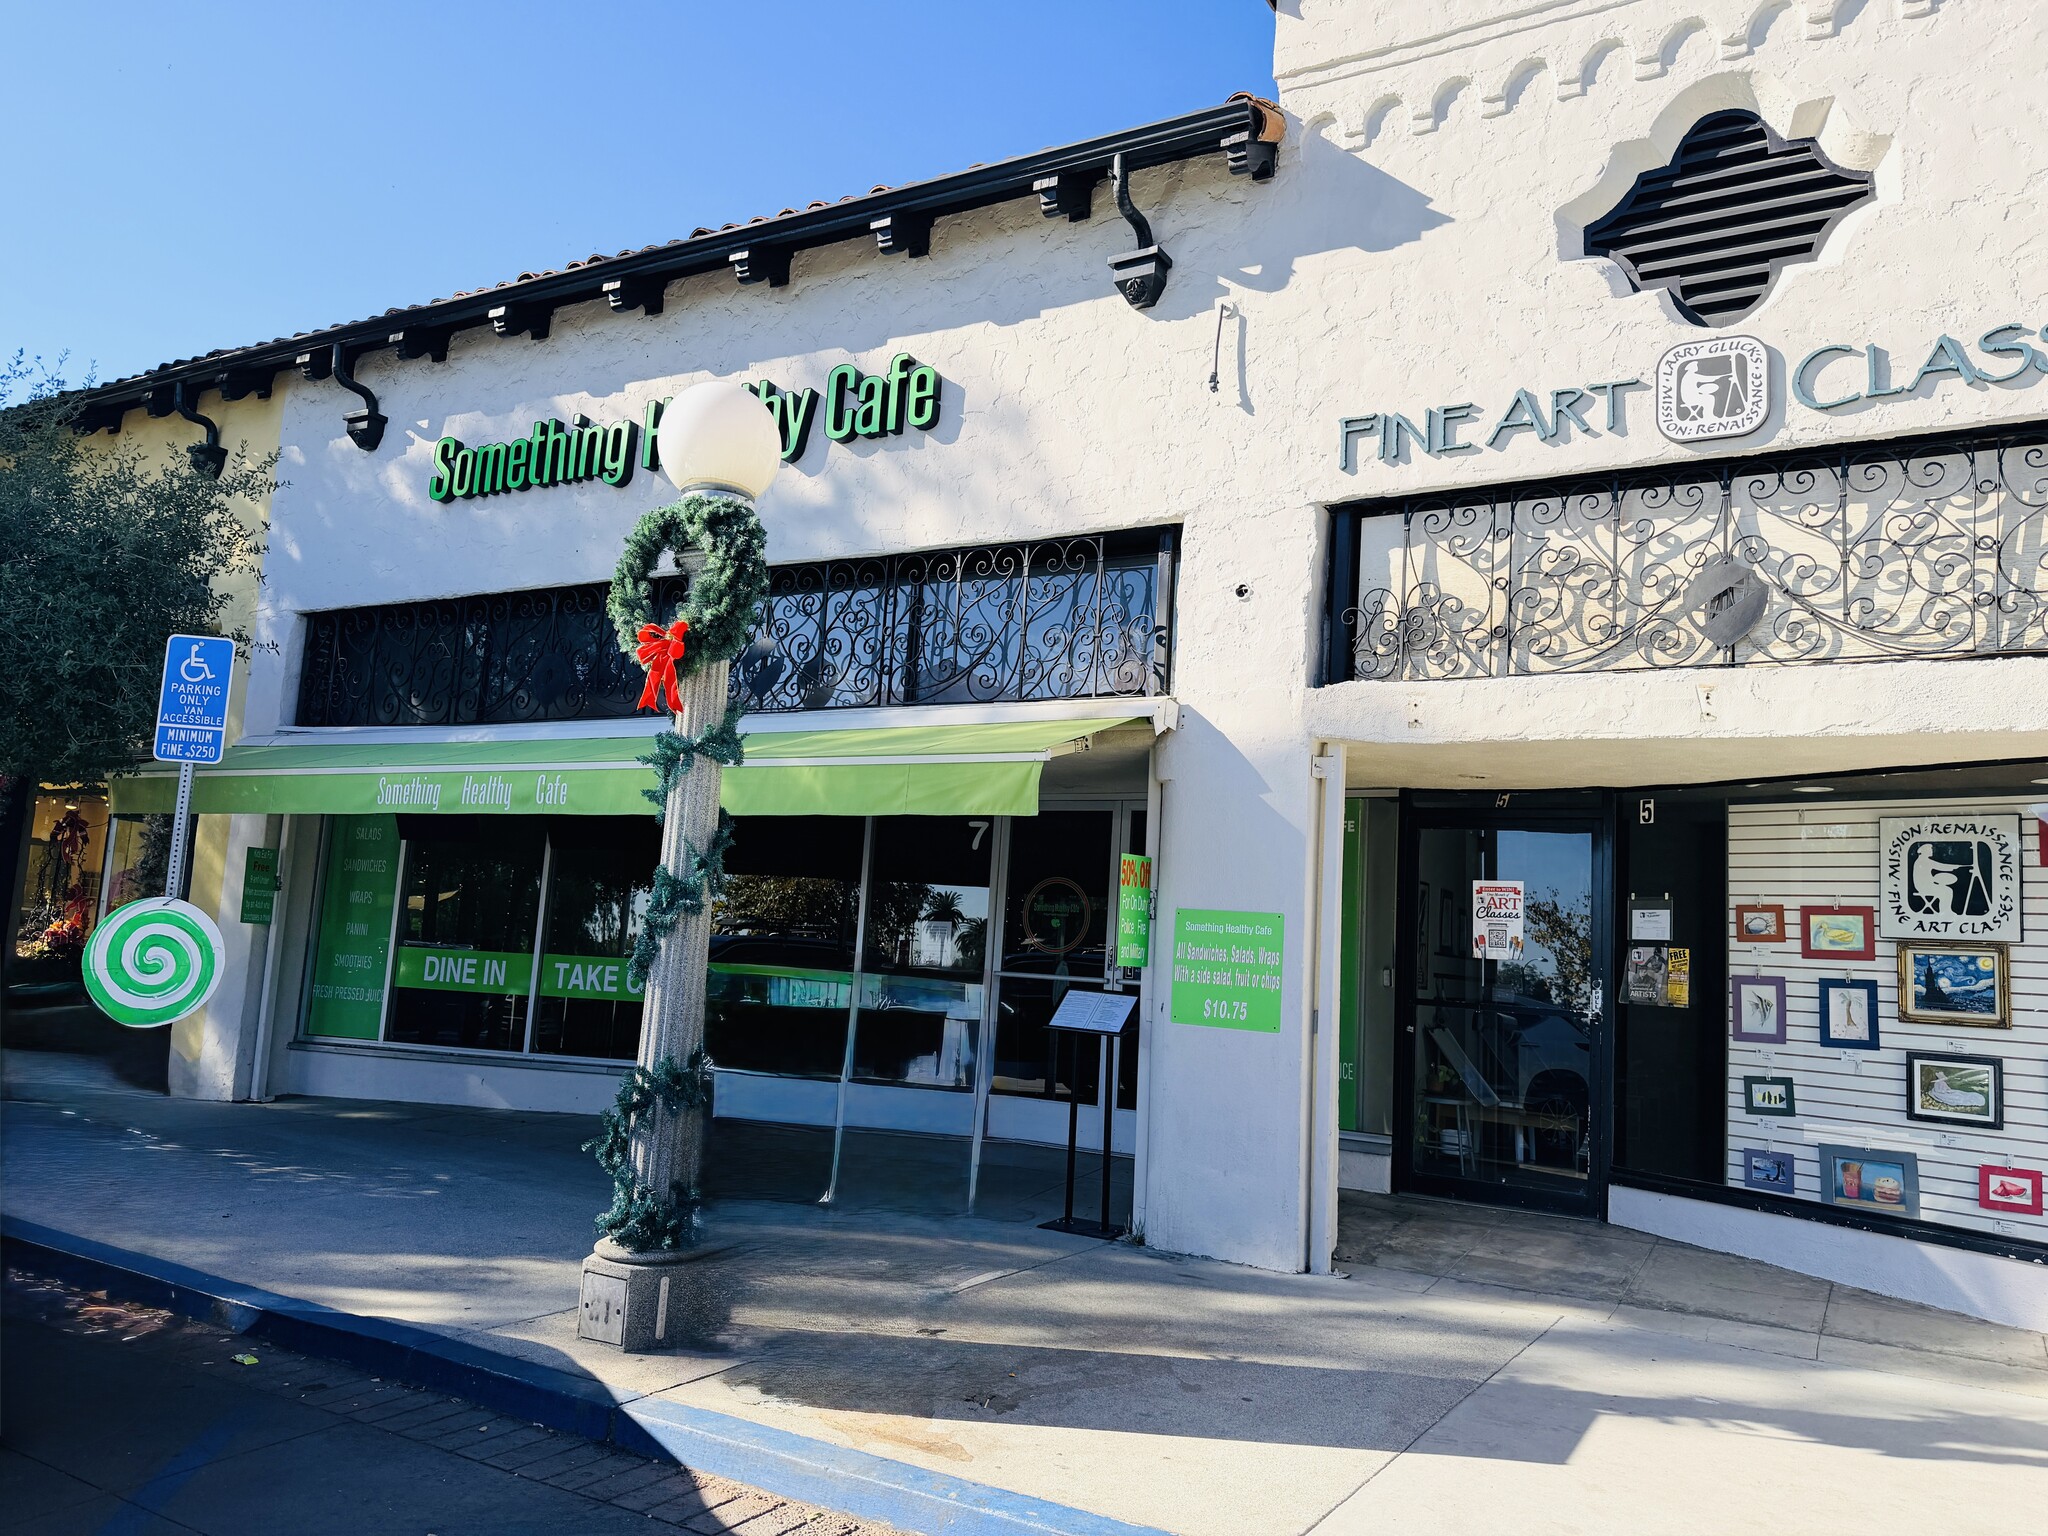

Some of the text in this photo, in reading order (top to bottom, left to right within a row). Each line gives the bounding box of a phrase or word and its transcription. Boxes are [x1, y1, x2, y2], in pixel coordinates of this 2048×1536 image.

[1663, 341, 1763, 376] LARRY GLUCK'S
[1338, 322, 2048, 471] FINE ART CLAS
[1696, 372, 1763, 435] RENAISSANCE
[430, 413, 634, 501] Something
[825, 353, 940, 443] Cafe
[170, 683, 221, 696] PARKING
[180, 694, 210, 706] ONLY
[184, 706, 203, 715] VAN
[162, 713, 222, 726] ACCESSIBLE
[167, 728, 213, 743] MINIMUM
[161, 743, 215, 758] FINE $250
[377, 774, 568, 811] Something Healthy Cafe
[1641, 800, 1653, 823] 5
[356, 827, 382, 841] SALADS
[968, 821, 989, 850] 7
[1930, 823, 2013, 882] RENAISSANCE
[253, 861, 270, 872] Free
[343, 859, 387, 873] SANDWICHES
[1121, 859, 1151, 888] 50% Off
[350, 891, 373, 904] WRAPS
[1122, 894, 1148, 915] For On Duty
[1487, 897, 1521, 910] ART
[1476, 906, 1521, 919] Classes
[1888, 890, 2014, 934] FINE ART CLASSES
[345, 922, 369, 936] PANINI
[1137, 919, 1146, 935] Fire
[1185, 921, 1272, 936] Something Healthy Cafe
[1120, 943, 1145, 963] and Military
[1176, 942, 1280, 969] All Sandwiches, Salads, Wraps
[1669, 949, 1687, 961] FREE
[334, 954, 373, 969] SMOOTHIES
[423, 956, 507, 986] DINE IN
[555, 963, 619, 992] TAKE
[1174, 964, 1280, 992] With a side salad, fruit or chips
[312, 984, 333, 998] FRESH
[334, 986, 365, 1000] PRESSED
[1630, 990, 1657, 998] ARTISTS
[1203, 998, 1248, 1020] $10.75
[1340, 1062, 1353, 1080] ICE
